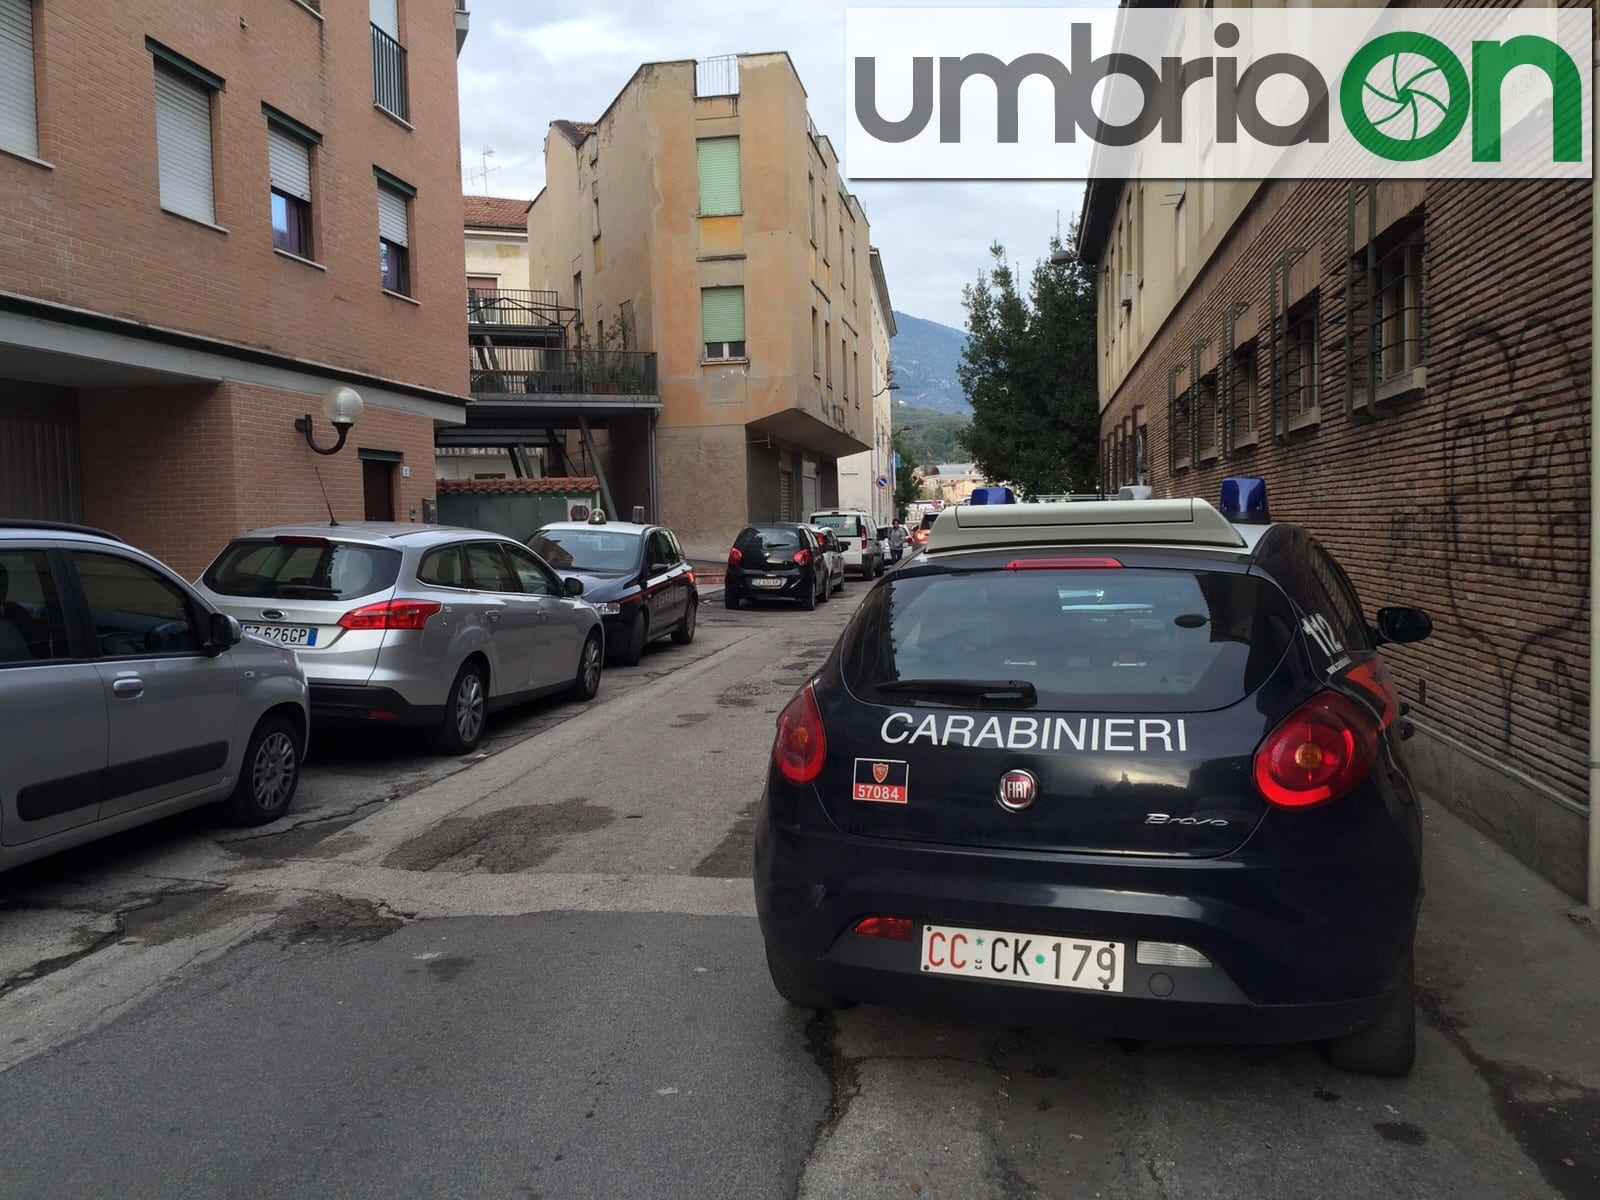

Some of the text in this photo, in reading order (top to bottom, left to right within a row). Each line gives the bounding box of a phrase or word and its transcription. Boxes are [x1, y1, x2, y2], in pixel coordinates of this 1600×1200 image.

[264, 627, 307, 643] 626GP
[1301, 613, 1345, 656] 112
[880, 712, 1188, 752] CARABINIERI
[858, 784, 900, 801] 57084
[1007, 780, 1029, 799] FIAT
[1144, 813, 1229, 827] Bravo
[928, 931, 1117, 985] CC CK 179
